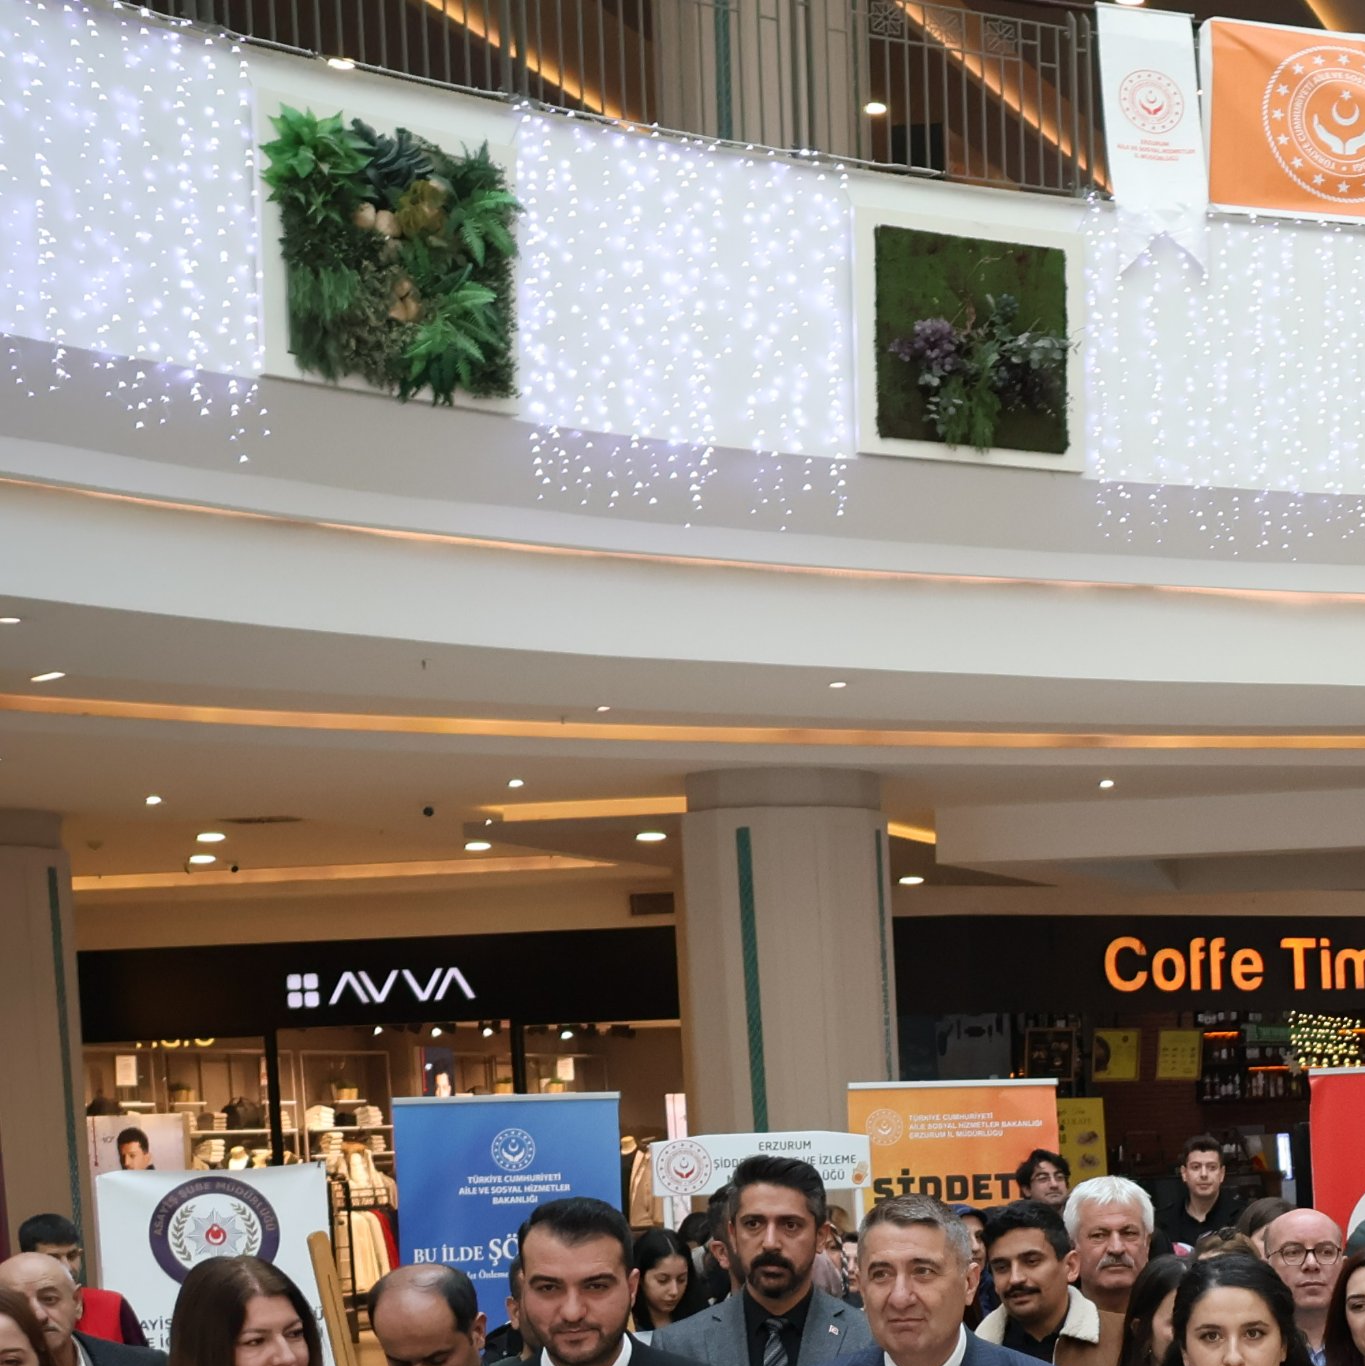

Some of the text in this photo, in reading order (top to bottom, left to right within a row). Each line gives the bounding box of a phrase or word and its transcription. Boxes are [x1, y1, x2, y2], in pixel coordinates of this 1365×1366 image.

[1104, 936, 1264, 992] Coffe
[329, 967, 476, 1005] AVVA
[758, 1140, 812, 1151] ERZURUM
[818, 1154, 857, 1165] İZLEME
[467, 1172, 561, 1184] TÜRKİYE CUMHURİYETİ
[458, 1182, 571, 1195] AİLE VE SOSYAL HİZMETLER
[492, 1194, 538, 1205] BAKANLIĞI
[413, 1233, 519, 1266] BU İLDE ŞÖ
